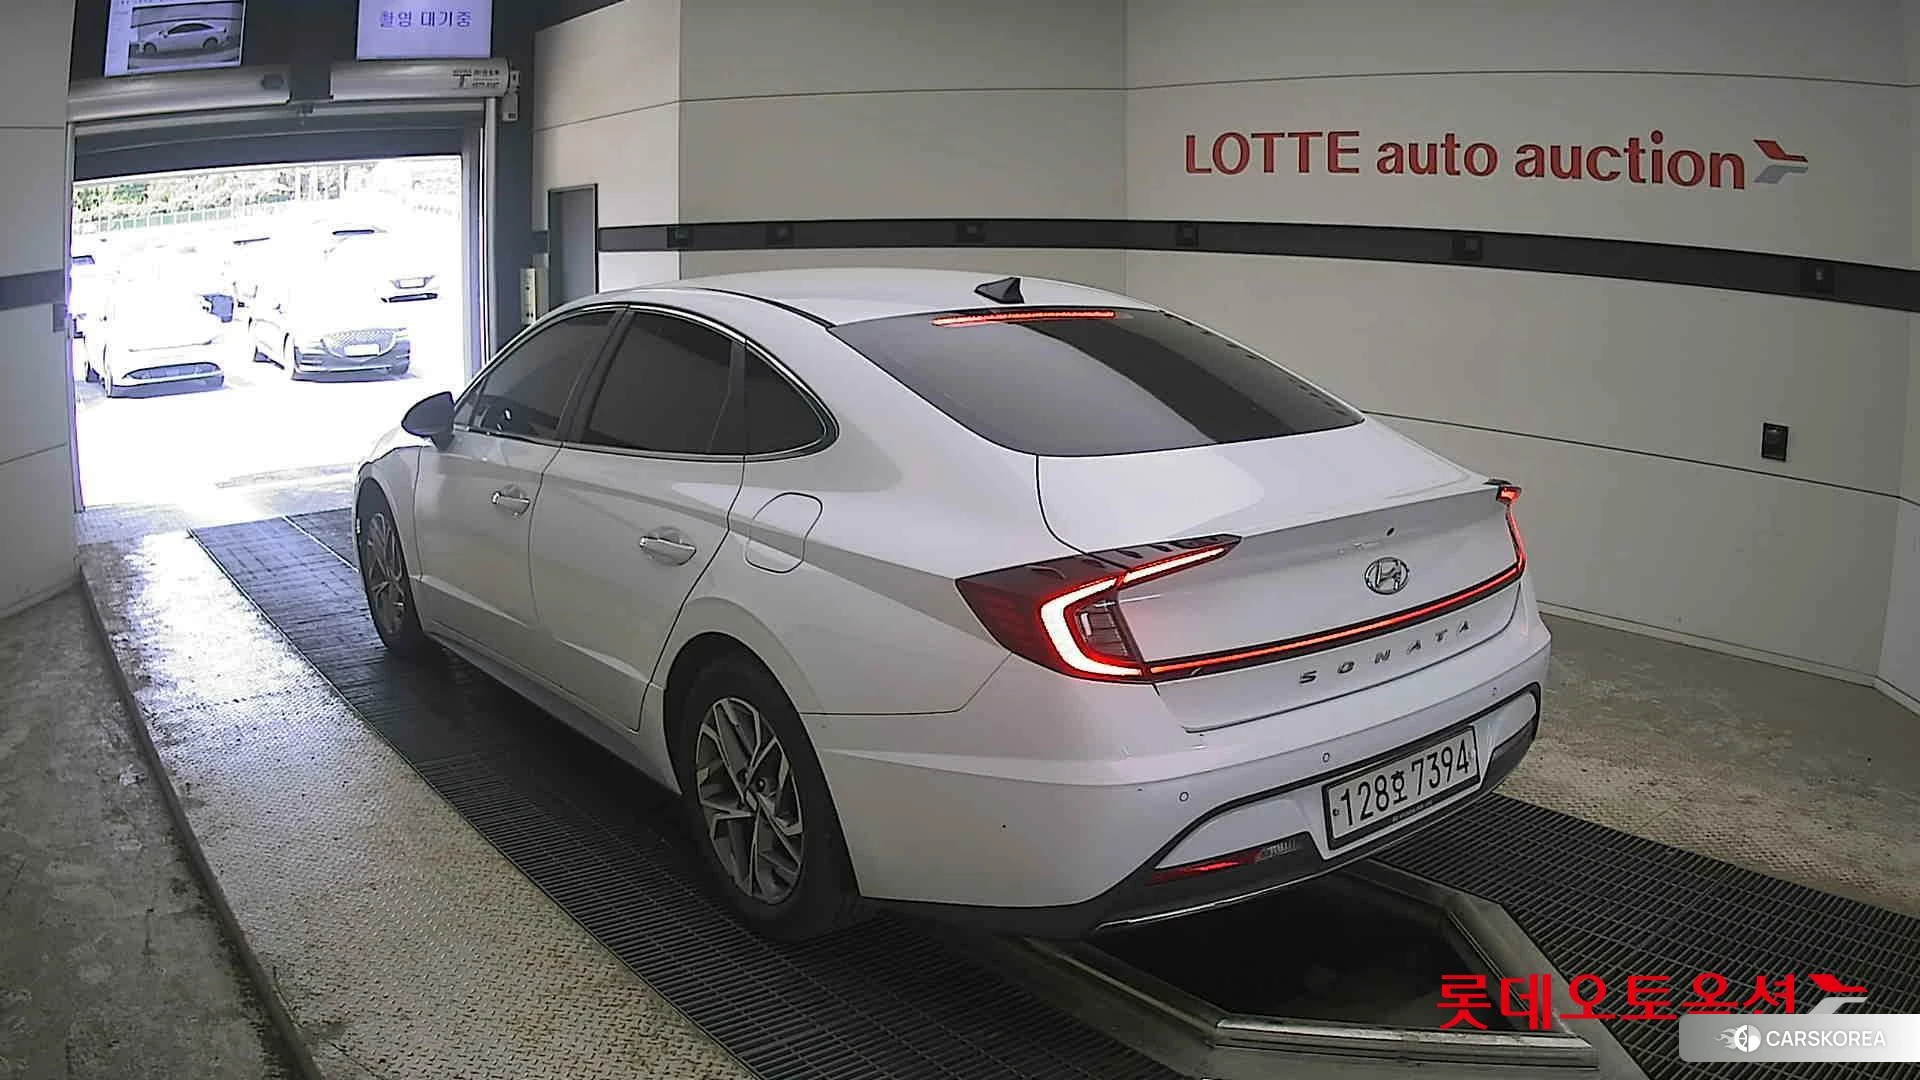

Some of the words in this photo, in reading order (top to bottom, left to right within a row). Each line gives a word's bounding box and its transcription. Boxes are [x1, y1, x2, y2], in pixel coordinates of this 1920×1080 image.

[420, 11, 471, 27] 대기중
[1185, 131, 1360, 174] LOTTE
[1377, 133, 1498, 176] auto
[1515, 130, 1745, 189] auction
[1300, 621, 1469, 684] SONATA
[1411, 739, 1469, 796] 7394
